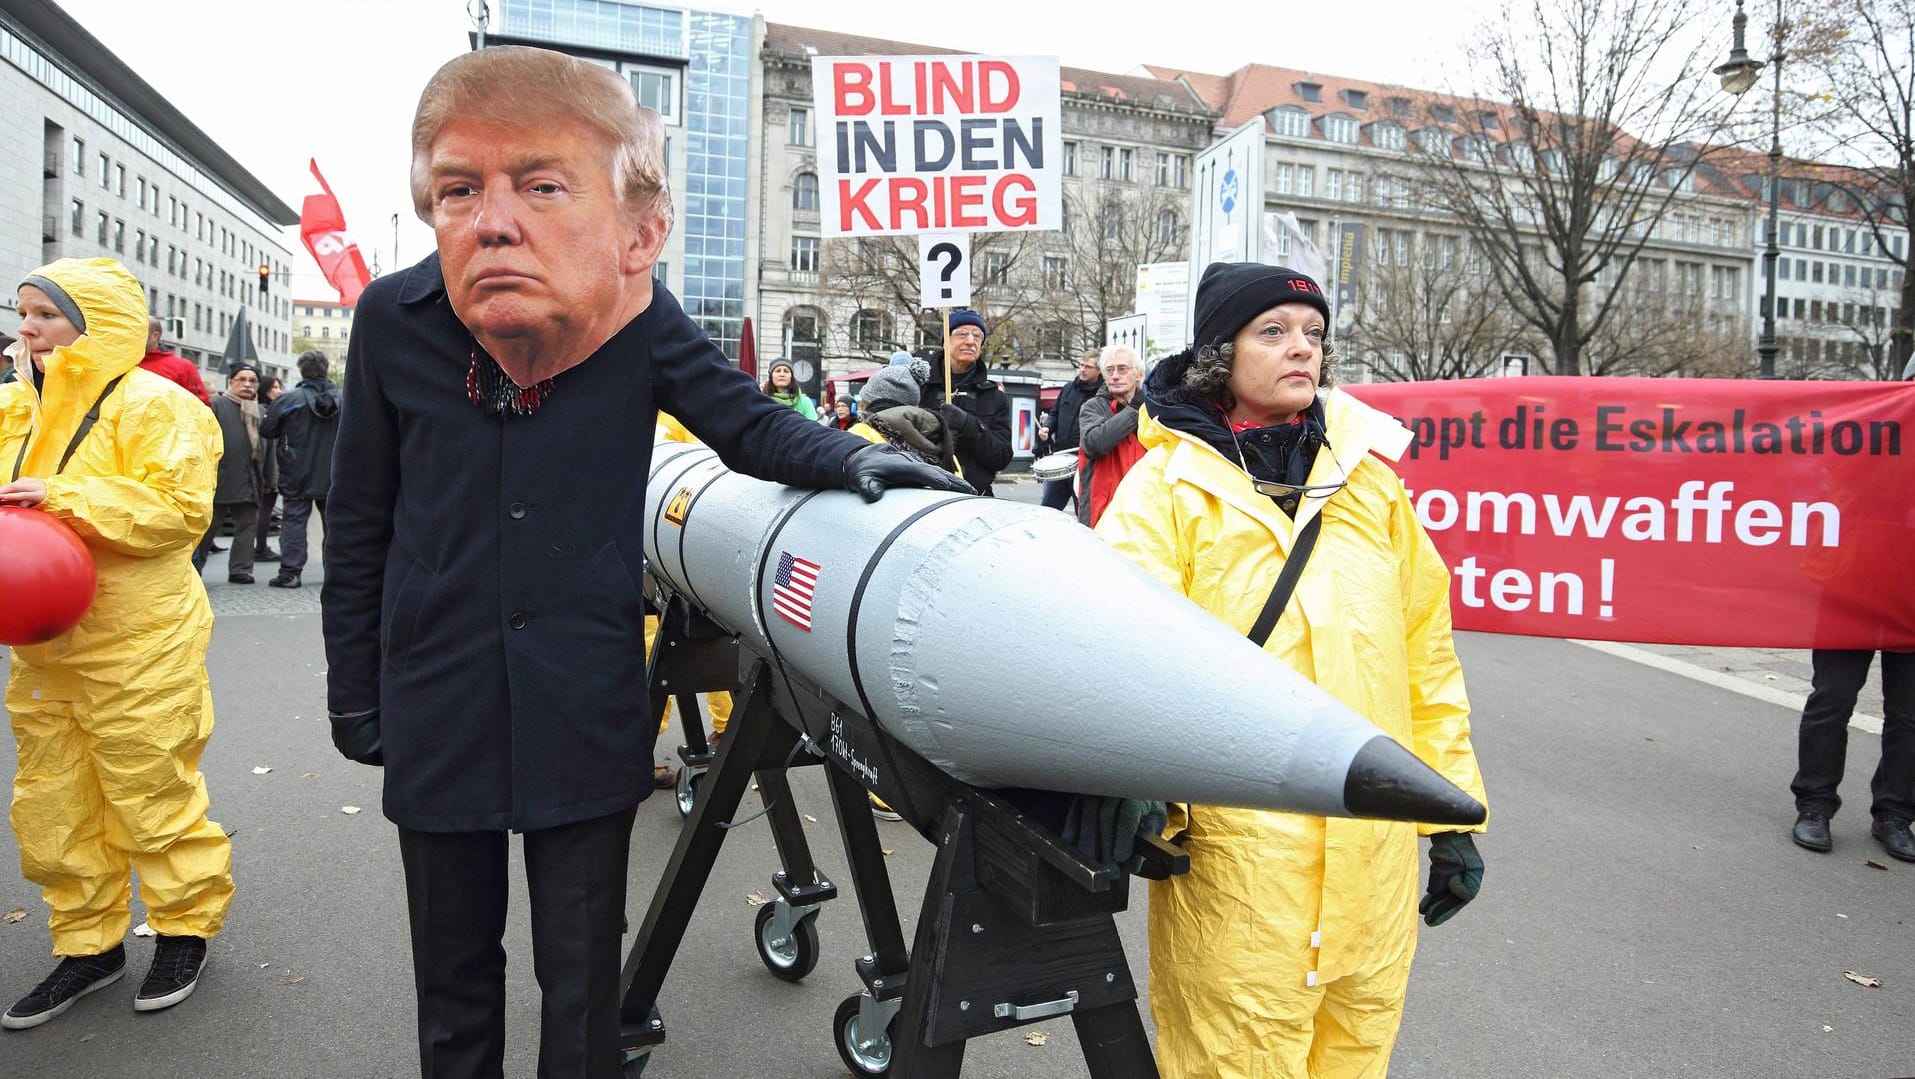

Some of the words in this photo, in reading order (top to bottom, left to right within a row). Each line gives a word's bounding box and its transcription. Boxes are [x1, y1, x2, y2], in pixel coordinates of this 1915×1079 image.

[833, 60, 1021, 116] BLIND
[835, 120, 897, 174] IN
[913, 117, 1044, 173] DEN
[838, 173, 1038, 232] KRIEG
[927, 242, 963, 299] ?
[1395, 409, 1487, 460] ppt
[1500, 405, 1579, 452] die
[1594, 405, 1903, 457] Eskalation
[830, 711, 843, 738] B61
